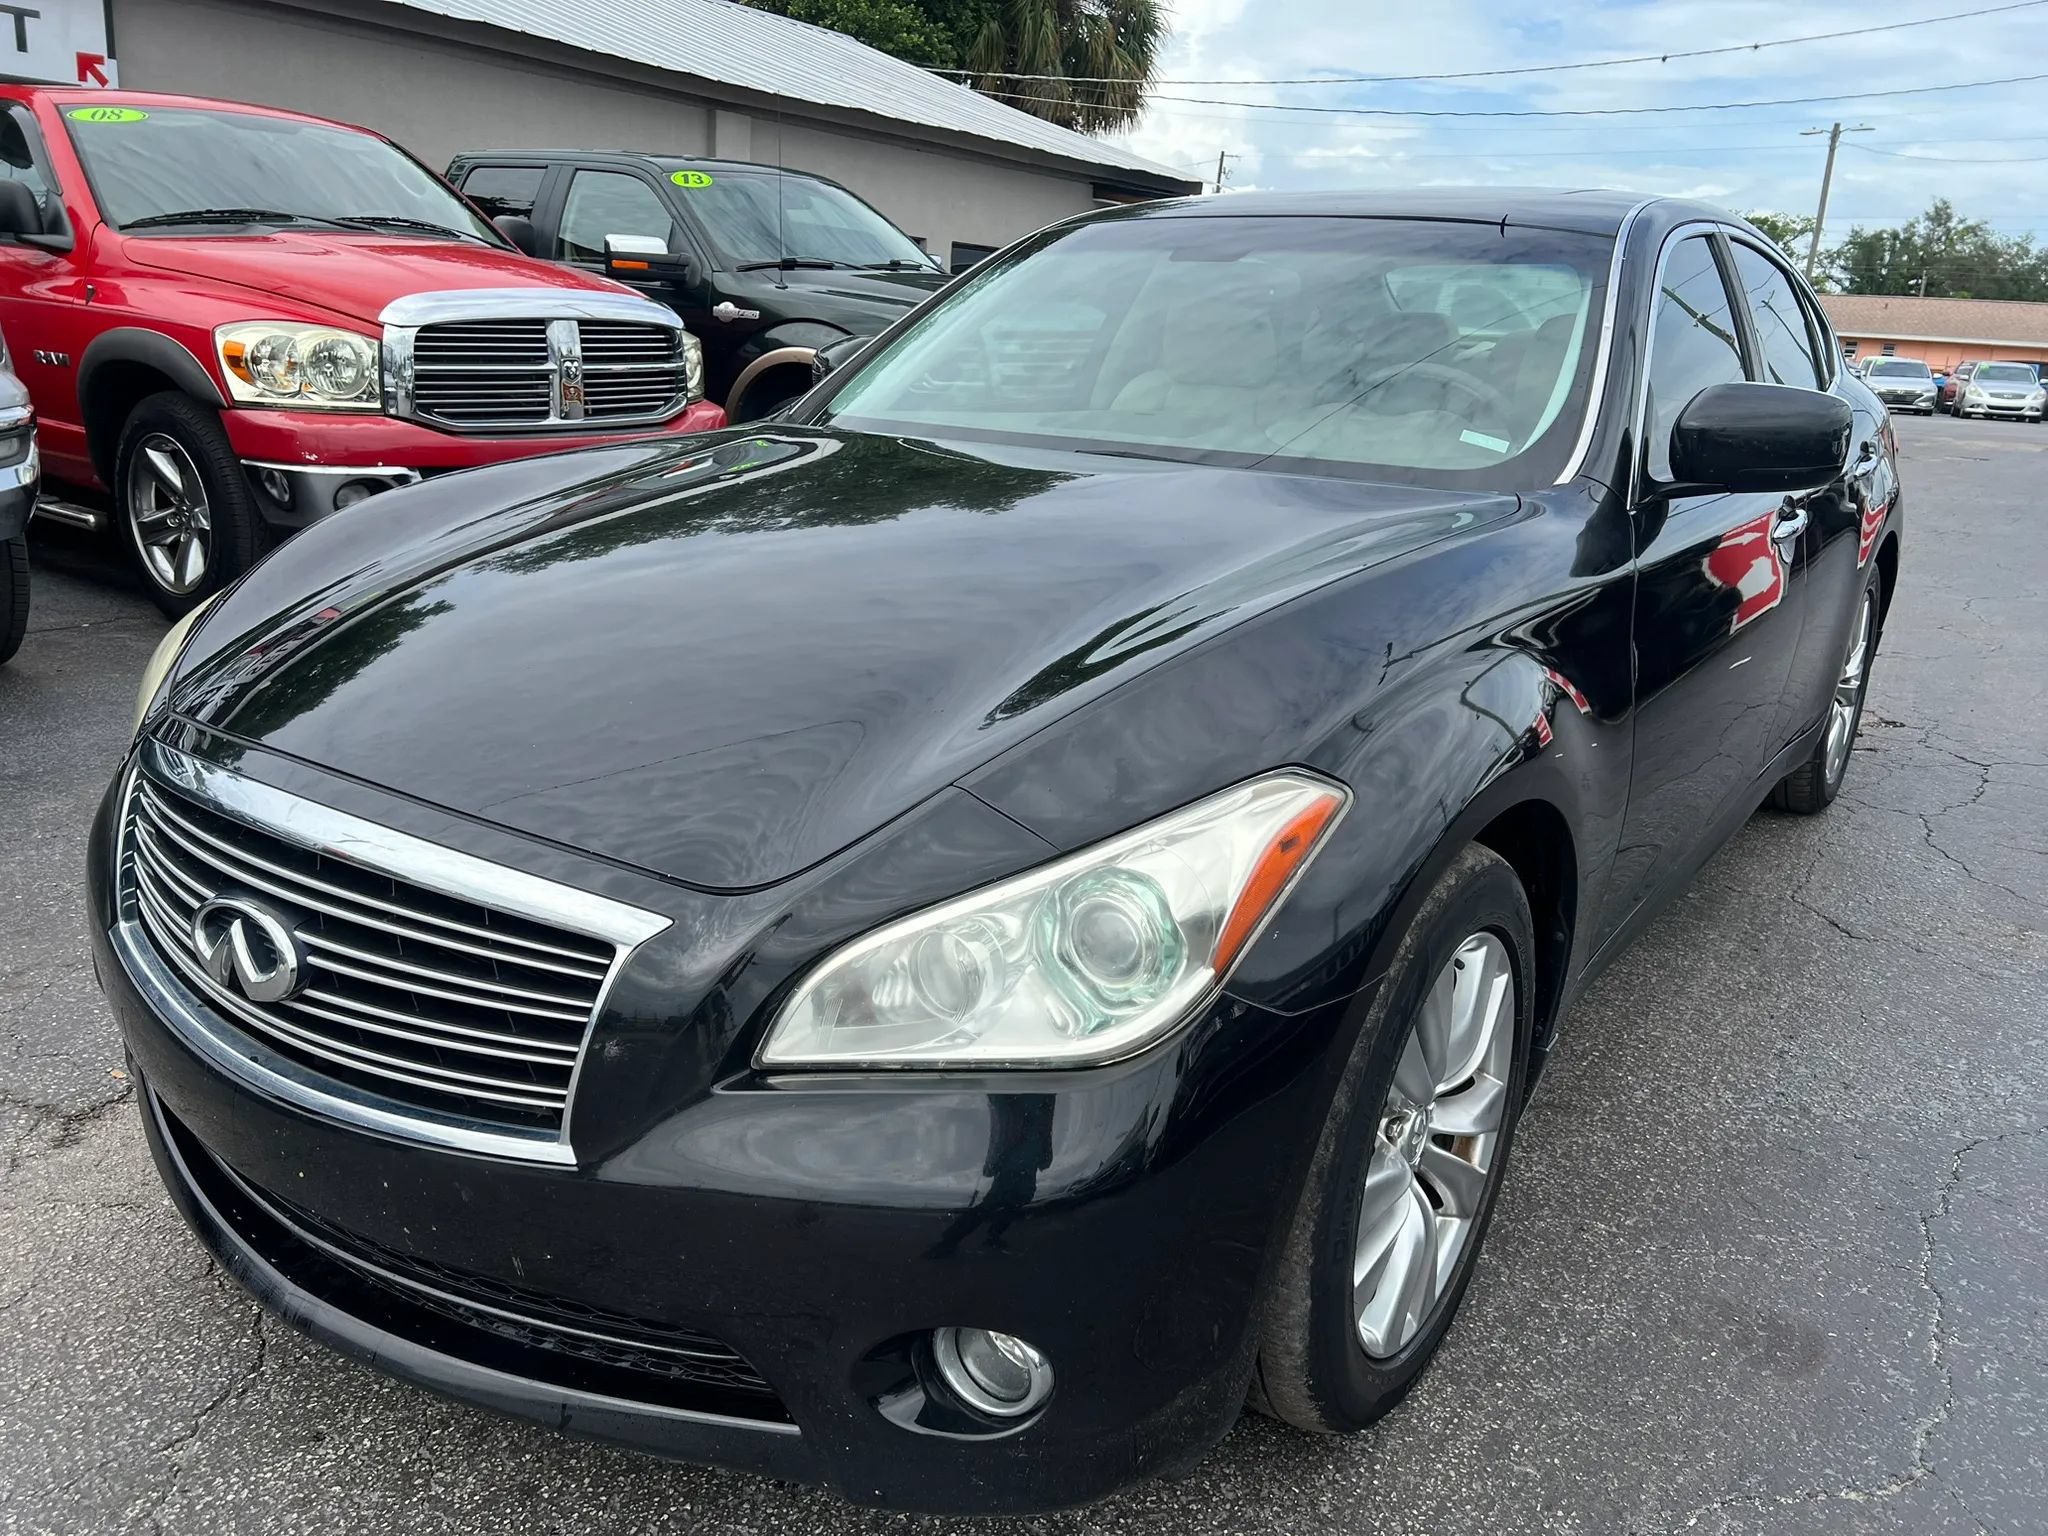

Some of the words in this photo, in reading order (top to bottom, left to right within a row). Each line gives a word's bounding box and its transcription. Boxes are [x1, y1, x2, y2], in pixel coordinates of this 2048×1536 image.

[91, 109, 123, 121] 08
[680, 173, 704, 185] 13
[33, 350, 70, 366] RAM
